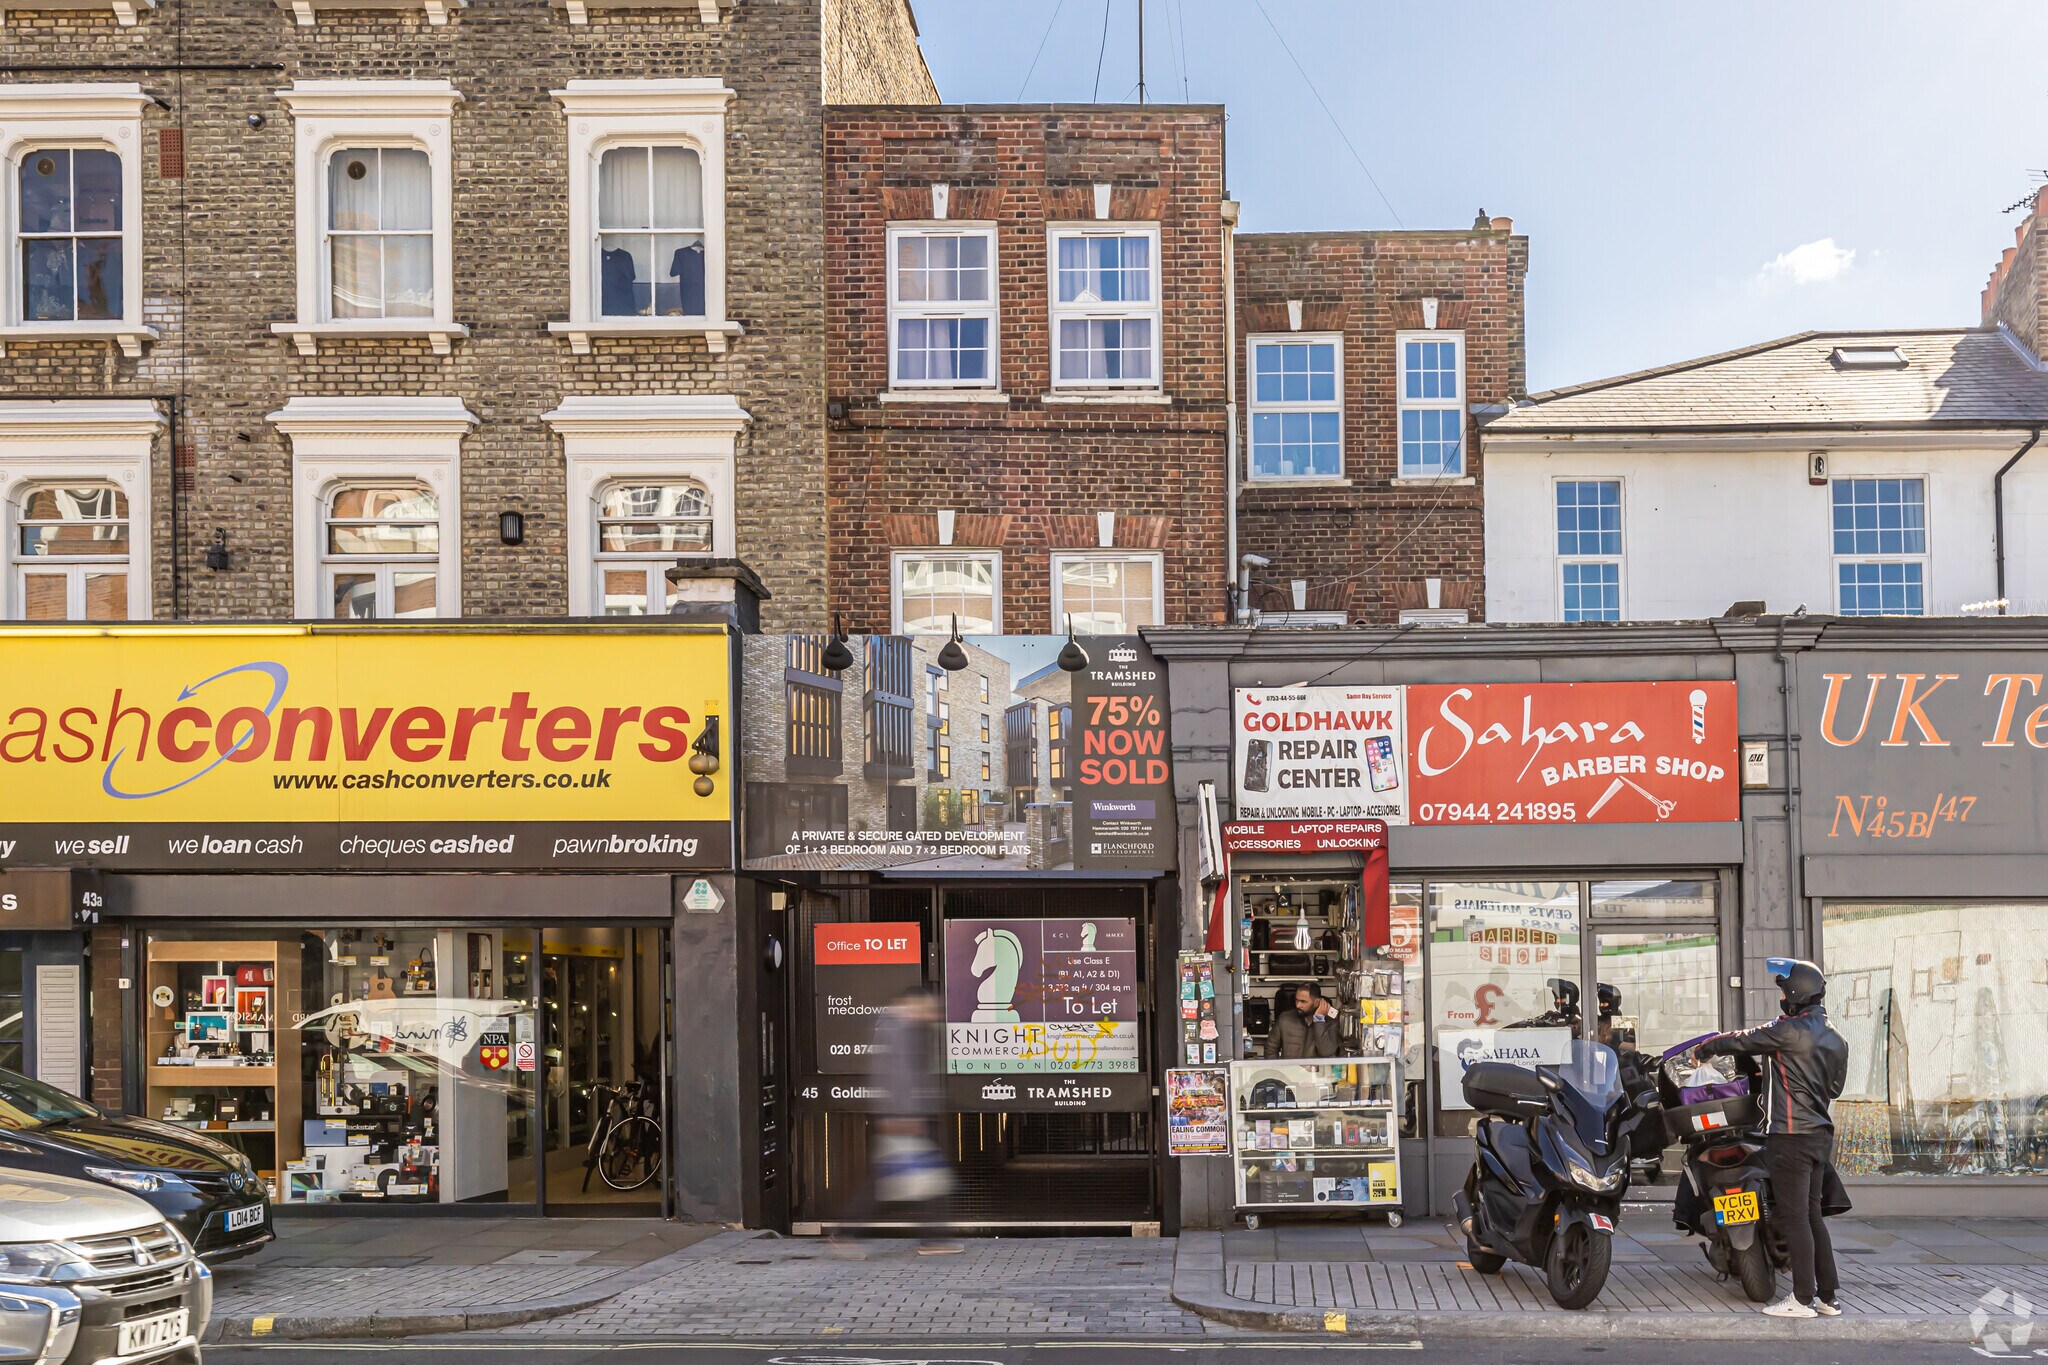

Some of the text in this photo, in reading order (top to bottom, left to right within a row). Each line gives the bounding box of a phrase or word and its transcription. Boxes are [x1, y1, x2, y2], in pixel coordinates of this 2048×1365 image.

[1090, 671, 1156, 681] TRAMSHED
[1087, 695, 1161, 727] 75%
[1820, 673, 1960, 747] UK
[1243, 710, 1394, 732] GOLDHAWK
[1084, 729, 1166, 756] NOW
[1417, 688, 1646, 784] Sahara
[1278, 739, 1358, 761] REPAIR
[1080, 759, 1169, 785] SOLD
[1277, 768, 1361, 789] CENTER
[1541, 755, 1725, 787] BARBER SHOP
[273, 769, 612, 790] www.cashconverters.co.uk
[1093, 802, 1137, 811] Winkworth
[1240, 805, 1401, 818] REPAIR & UNLOCKING MOBILE PC LAPTOP ACCESSORIES
[1419, 802, 1576, 821] 07944 241895
[791, 831, 1025, 841] A PRIVATE & SECURE GATED DEVELOPMENT
[1290, 825, 1333, 834] LAPTOP
[1335, 824, 1382, 833] REPAIRS
[54, 835, 130, 855] we sell
[168, 835, 304, 855] we loan cash
[340, 834, 515, 857] cheques cashed
[785, 845, 801, 855] OF
[803, 845, 809, 855] 1
[820, 845, 828, 855] 3
[830, 845, 886, 855] BEDROOM
[889, 845, 913, 855] AND
[940, 845, 997, 855] BEDROOM
[999, 845, 1031, 855] FLATS
[1316, 838, 1381, 848] UNLOCKING
[82, 892, 103, 908] 43a
[1470, 927, 1557, 944] BARBER
[827, 938, 908, 951] Office TO LET
[1083, 956, 1103, 965] Class
[1105, 957, 1110, 965] E
[1480, 946, 1548, 965] SHOP
[1073, 970, 1085, 979] A1,
[1086, 970, 1097, 978] A2
[1100, 970, 1106, 978] &
[1108, 970, 1120, 980] D1)
[1071, 985, 1080, 993] sq
[1112, 984, 1121, 992] sq
[828, 995, 852, 1006] frost
[1063, 996, 1118, 1014] To Let
[1447, 1010, 1475, 1019] From
[483, 1034, 507, 1045] NPA
[951, 1028, 1041, 1044] KNIGHT
[830, 1044, 851, 1055] 020
[951, 1046, 1041, 1056] COMMERCIAL
[1482, 1048, 1541, 1060] SAHARA
[951, 1062, 1041, 1070] LONDON
[1084, 1061, 1103, 1070] 773
[1109, 1061, 1136, 1070] 3988
[802, 1087, 819, 1099] 45
[1028, 1088, 1112, 1099] TRAMSHED
[1700, 1114, 1721, 1130] L
[1718, 1194, 1752, 1210] YC16
[231, 1208, 262, 1227] LO14 BCF
[1726, 1206, 1756, 1222] RXV
